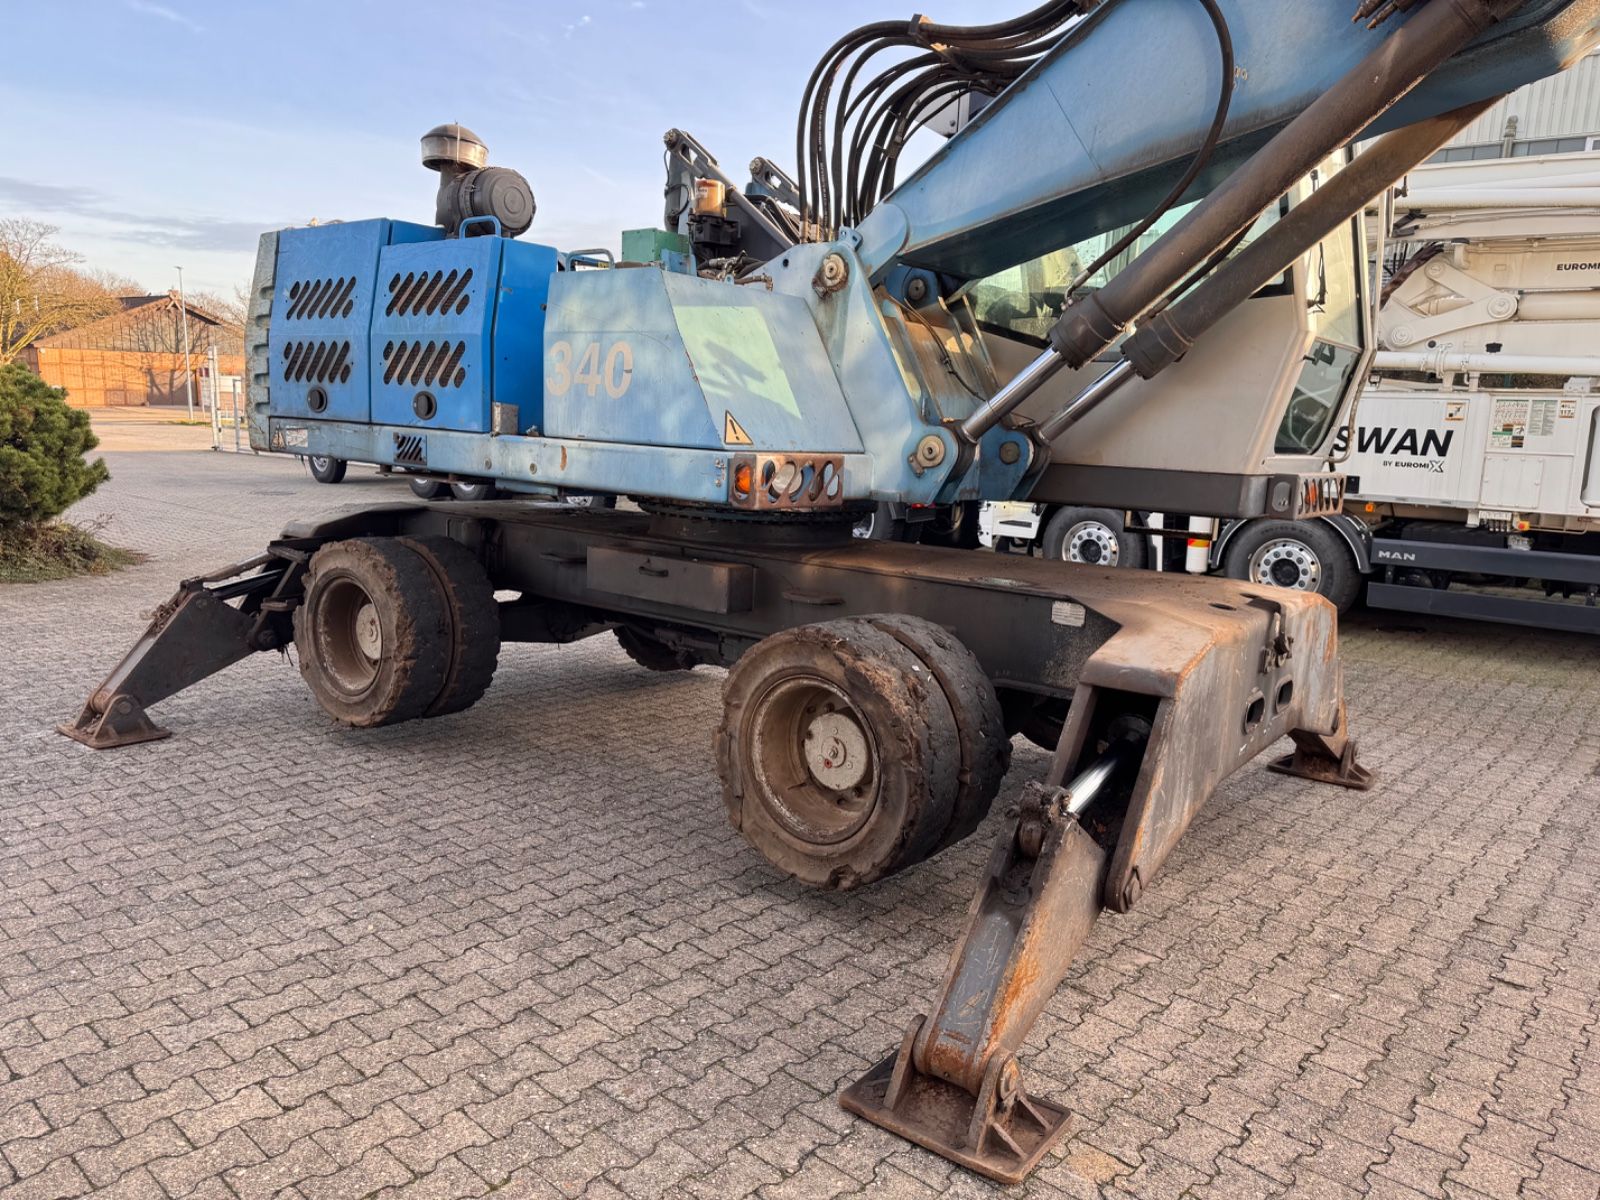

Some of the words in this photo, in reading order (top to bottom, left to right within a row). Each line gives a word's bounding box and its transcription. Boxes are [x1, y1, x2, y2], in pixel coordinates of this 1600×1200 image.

[546, 341, 633, 399] 340
[1333, 425, 1455, 457] SWAN
[1378, 550, 1416, 560] MAN
